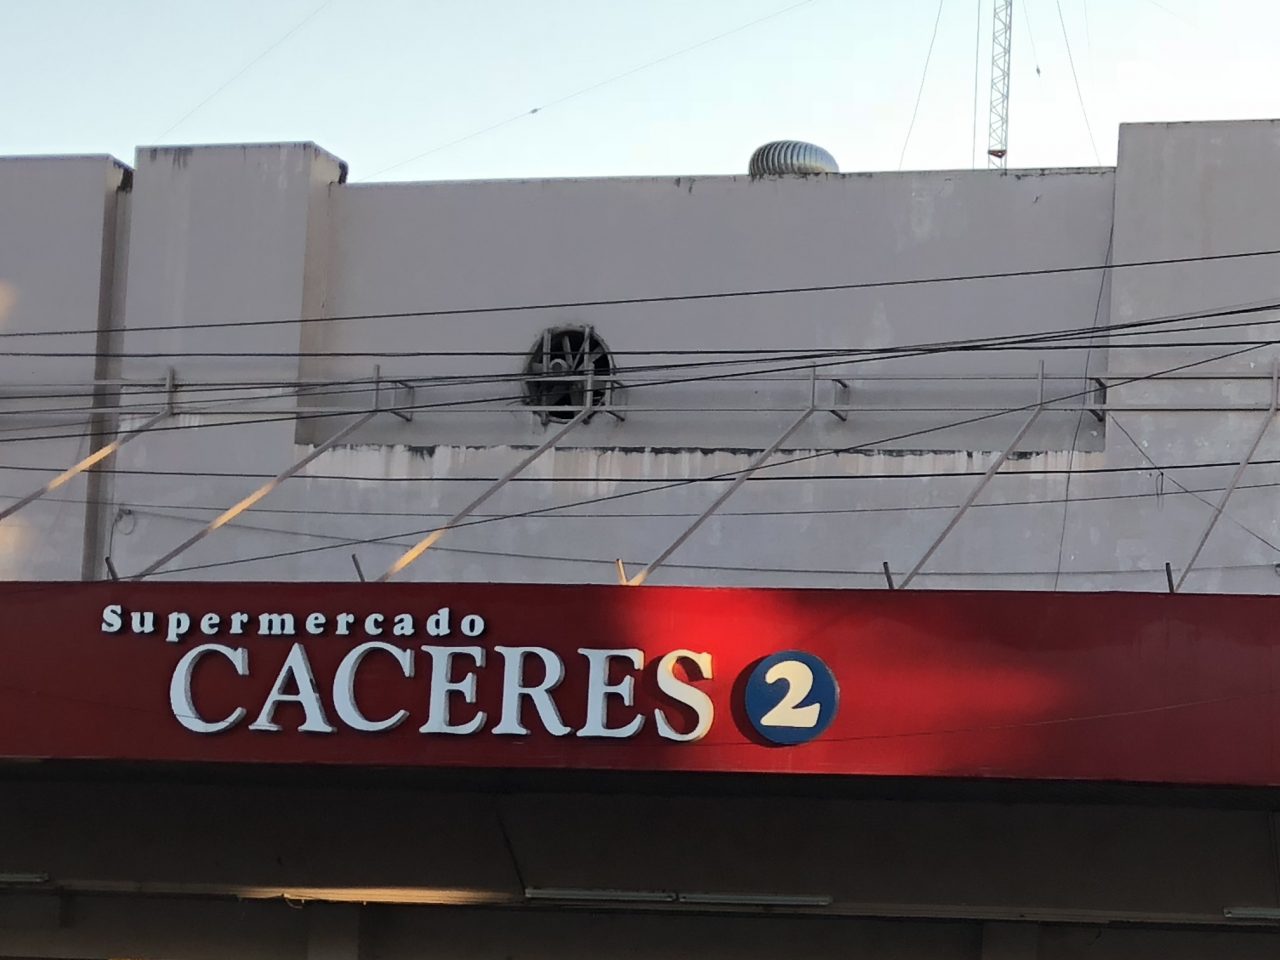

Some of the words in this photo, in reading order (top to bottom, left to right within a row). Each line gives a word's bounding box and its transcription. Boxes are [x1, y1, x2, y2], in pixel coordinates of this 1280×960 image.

[101, 604, 486, 642] Supermercado
[169, 641, 715, 741] CACERES
[760, 660, 821, 728] 2
